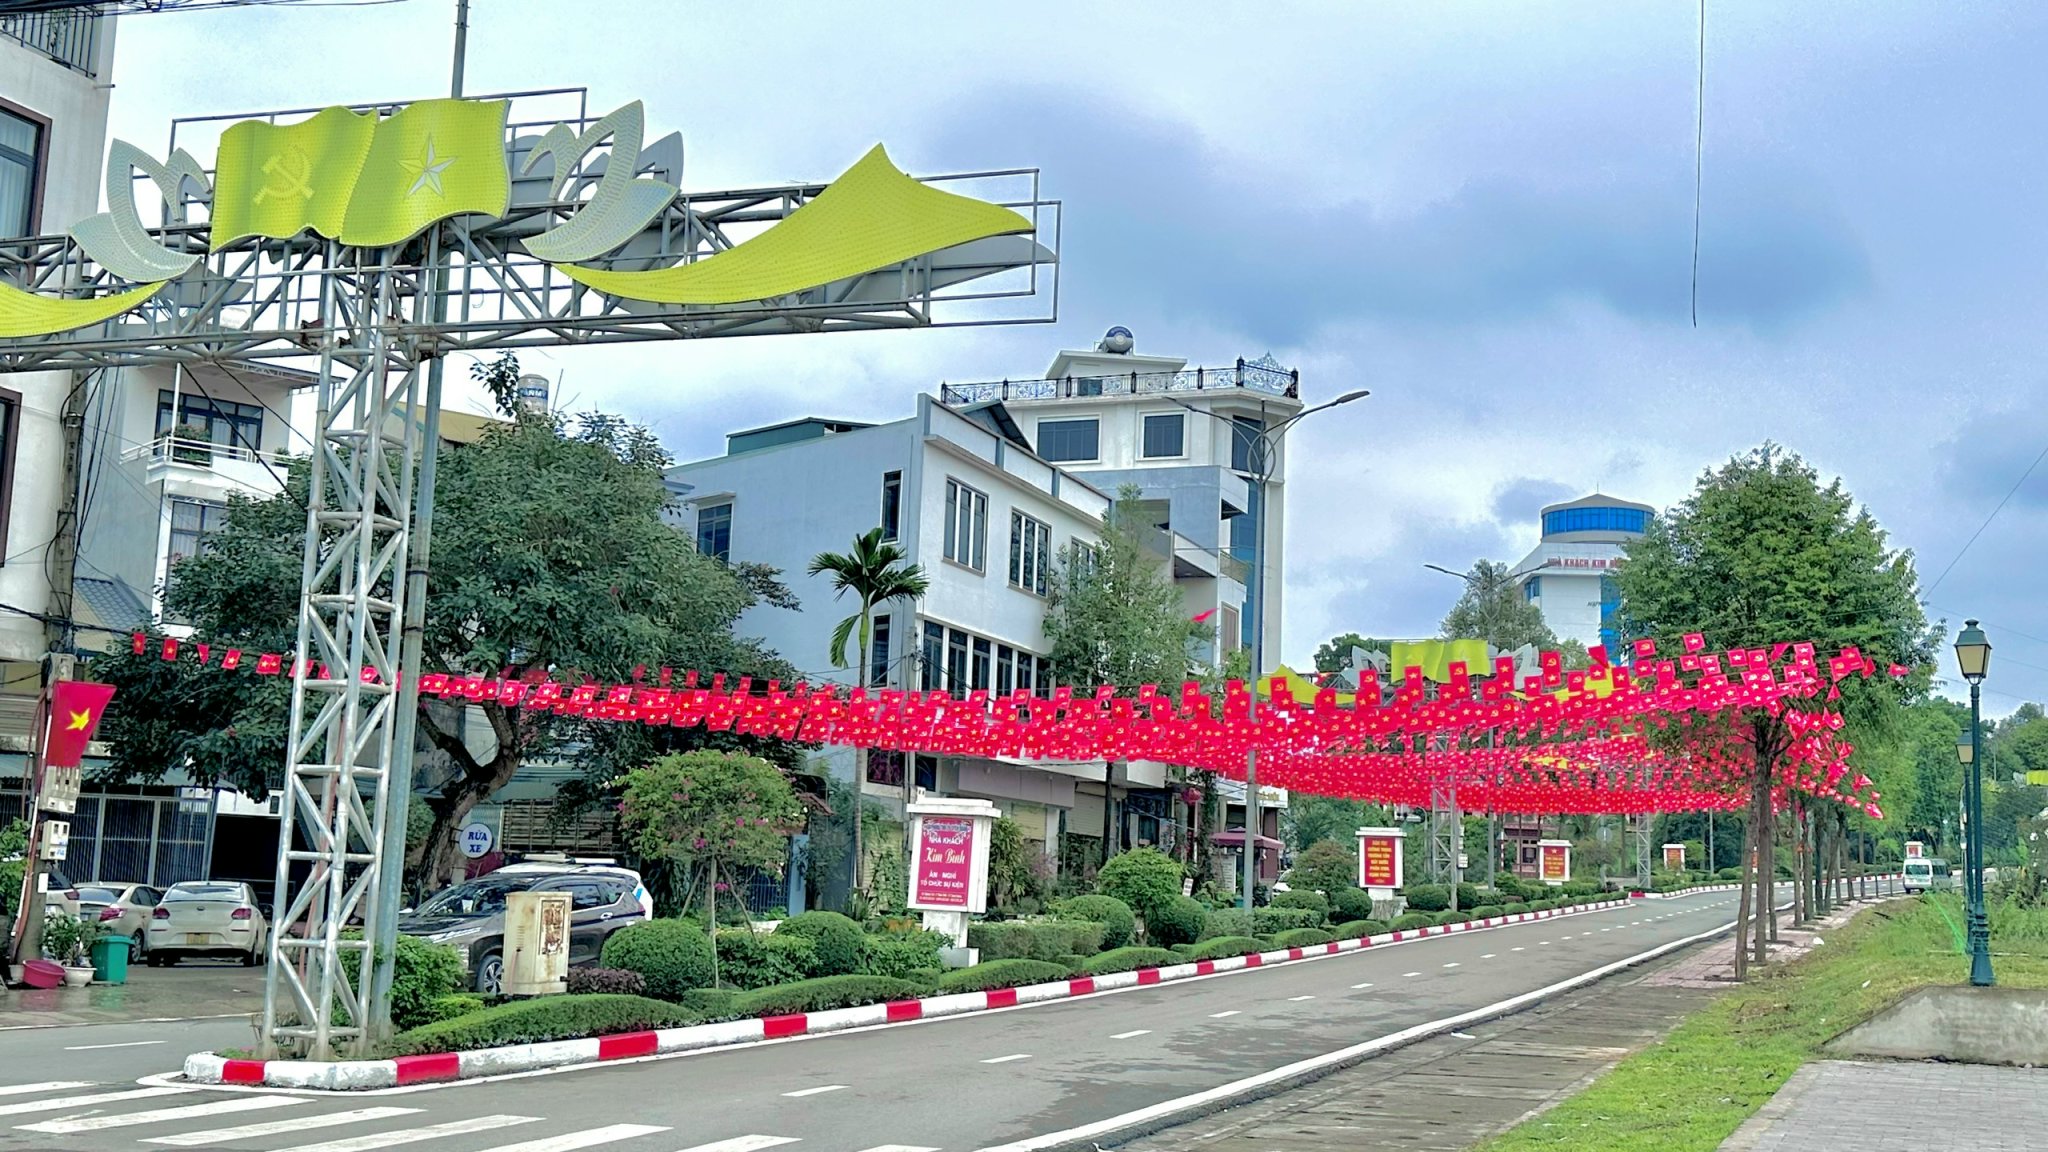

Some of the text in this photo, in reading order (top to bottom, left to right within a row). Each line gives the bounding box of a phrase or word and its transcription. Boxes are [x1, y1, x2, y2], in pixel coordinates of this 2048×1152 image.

[467, 829, 488, 841] RỬA
[469, 844, 482, 853] XE
[924, 847, 943, 863] Kim
